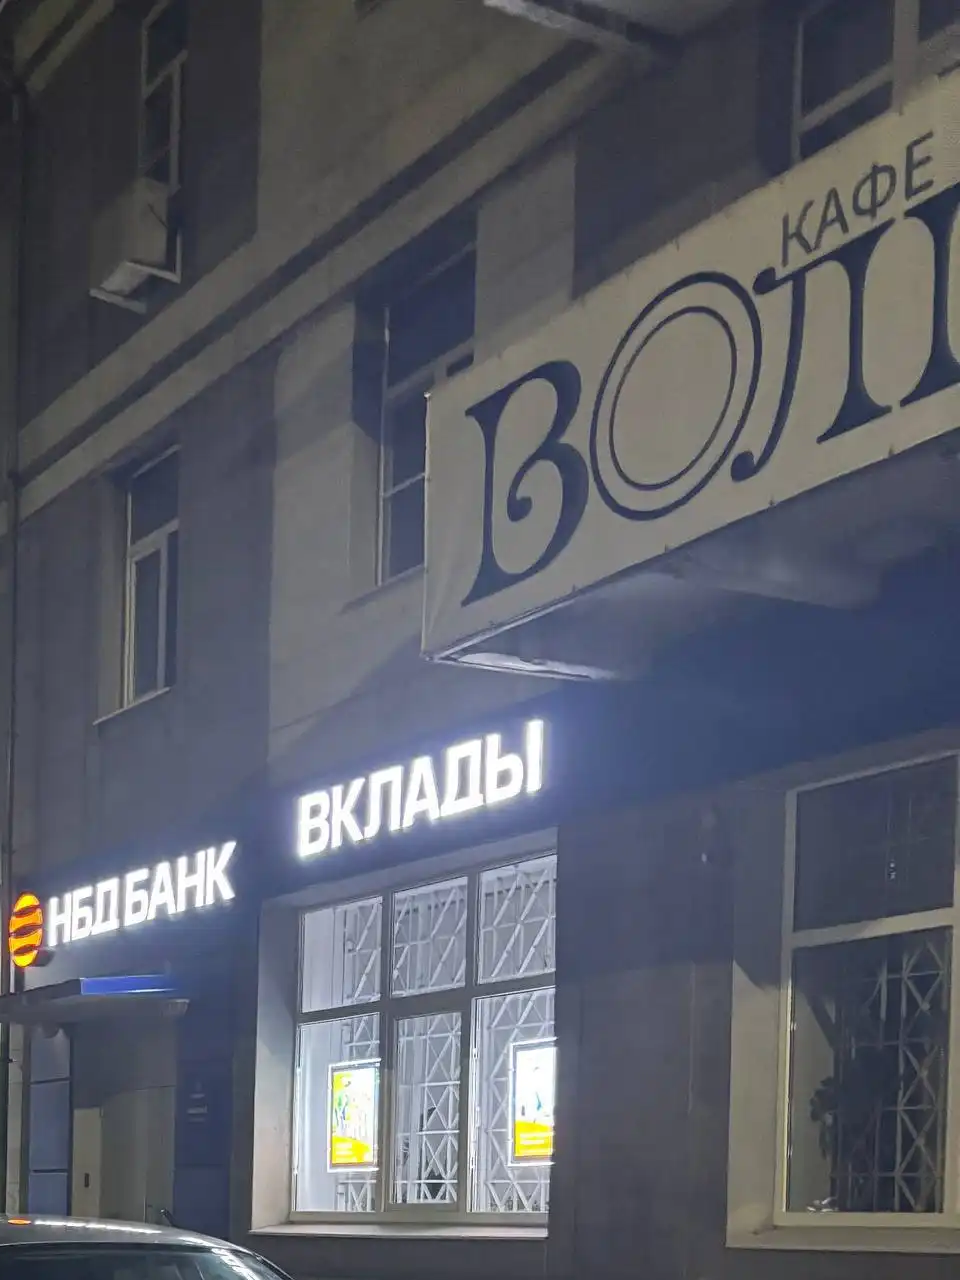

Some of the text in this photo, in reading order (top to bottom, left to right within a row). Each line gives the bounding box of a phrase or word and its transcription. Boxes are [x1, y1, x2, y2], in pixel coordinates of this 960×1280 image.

[781, 132, 935, 267] КАФЕ
[296, 719, 545, 858] ВКЛАДЫ
[46, 840, 238, 947] НБД БАНК
